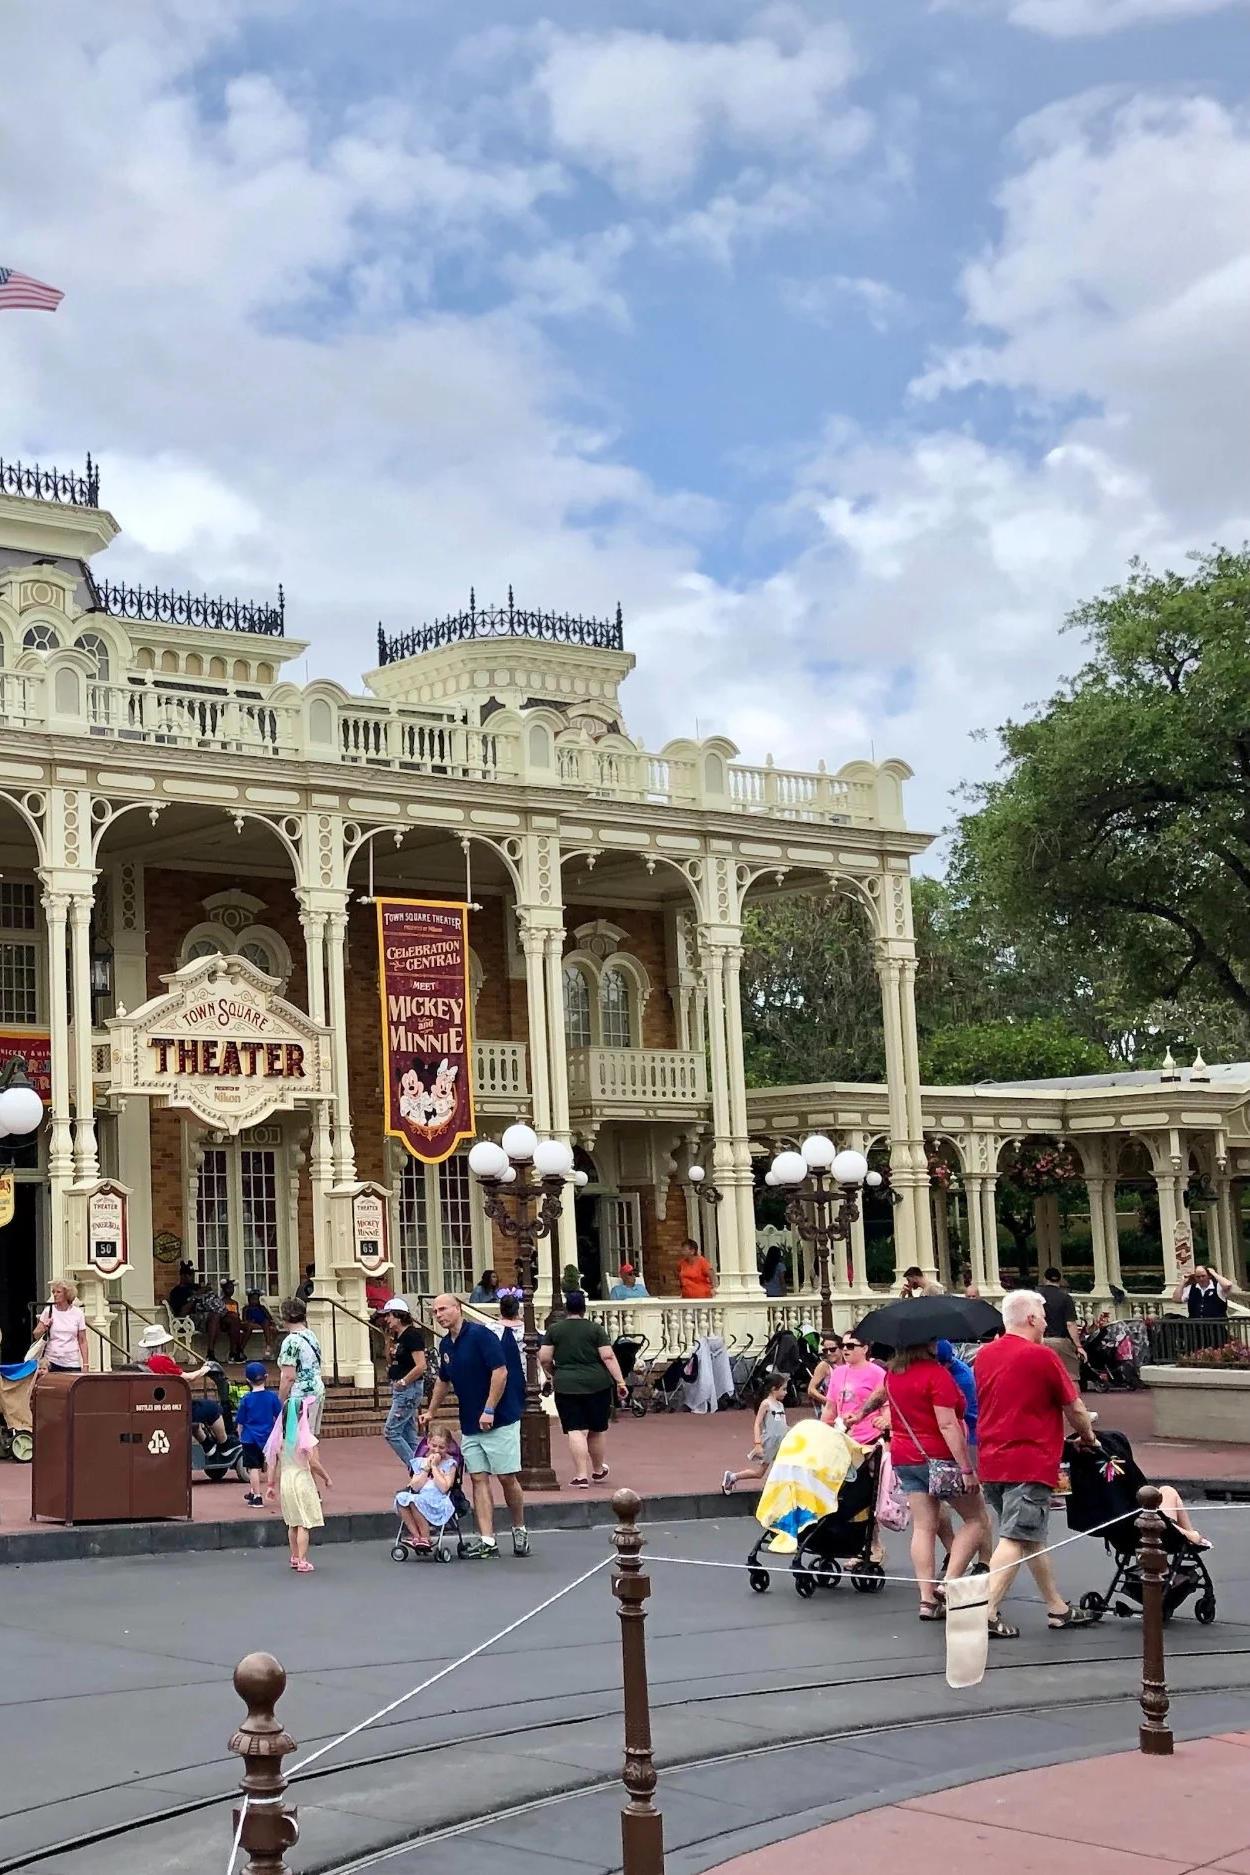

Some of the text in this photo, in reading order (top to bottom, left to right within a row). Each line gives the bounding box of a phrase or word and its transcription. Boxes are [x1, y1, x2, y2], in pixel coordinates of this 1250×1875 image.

[384, 913, 461, 930] TOWN SQUARE THEATER
[386, 940, 460, 960] CELEBRATION
[405, 953, 461, 971] CENTRAL
[412, 981, 436, 991] MEET
[182, 998, 269, 1032] TOWN SQUARE
[389, 995, 463, 1024] MICKEY
[417, 1019, 434, 1030] and
[390, 1025, 464, 1054] MINNIE
[147, 1037, 307, 1079] THEATER
[214, 1092, 241, 1103] Nikon
[357, 1220, 380, 1229] MICKEY
[357, 1228, 380, 1237] MINNIE
[100, 1243, 112, 1255] 50
[362, 1243, 374, 1254] 65
